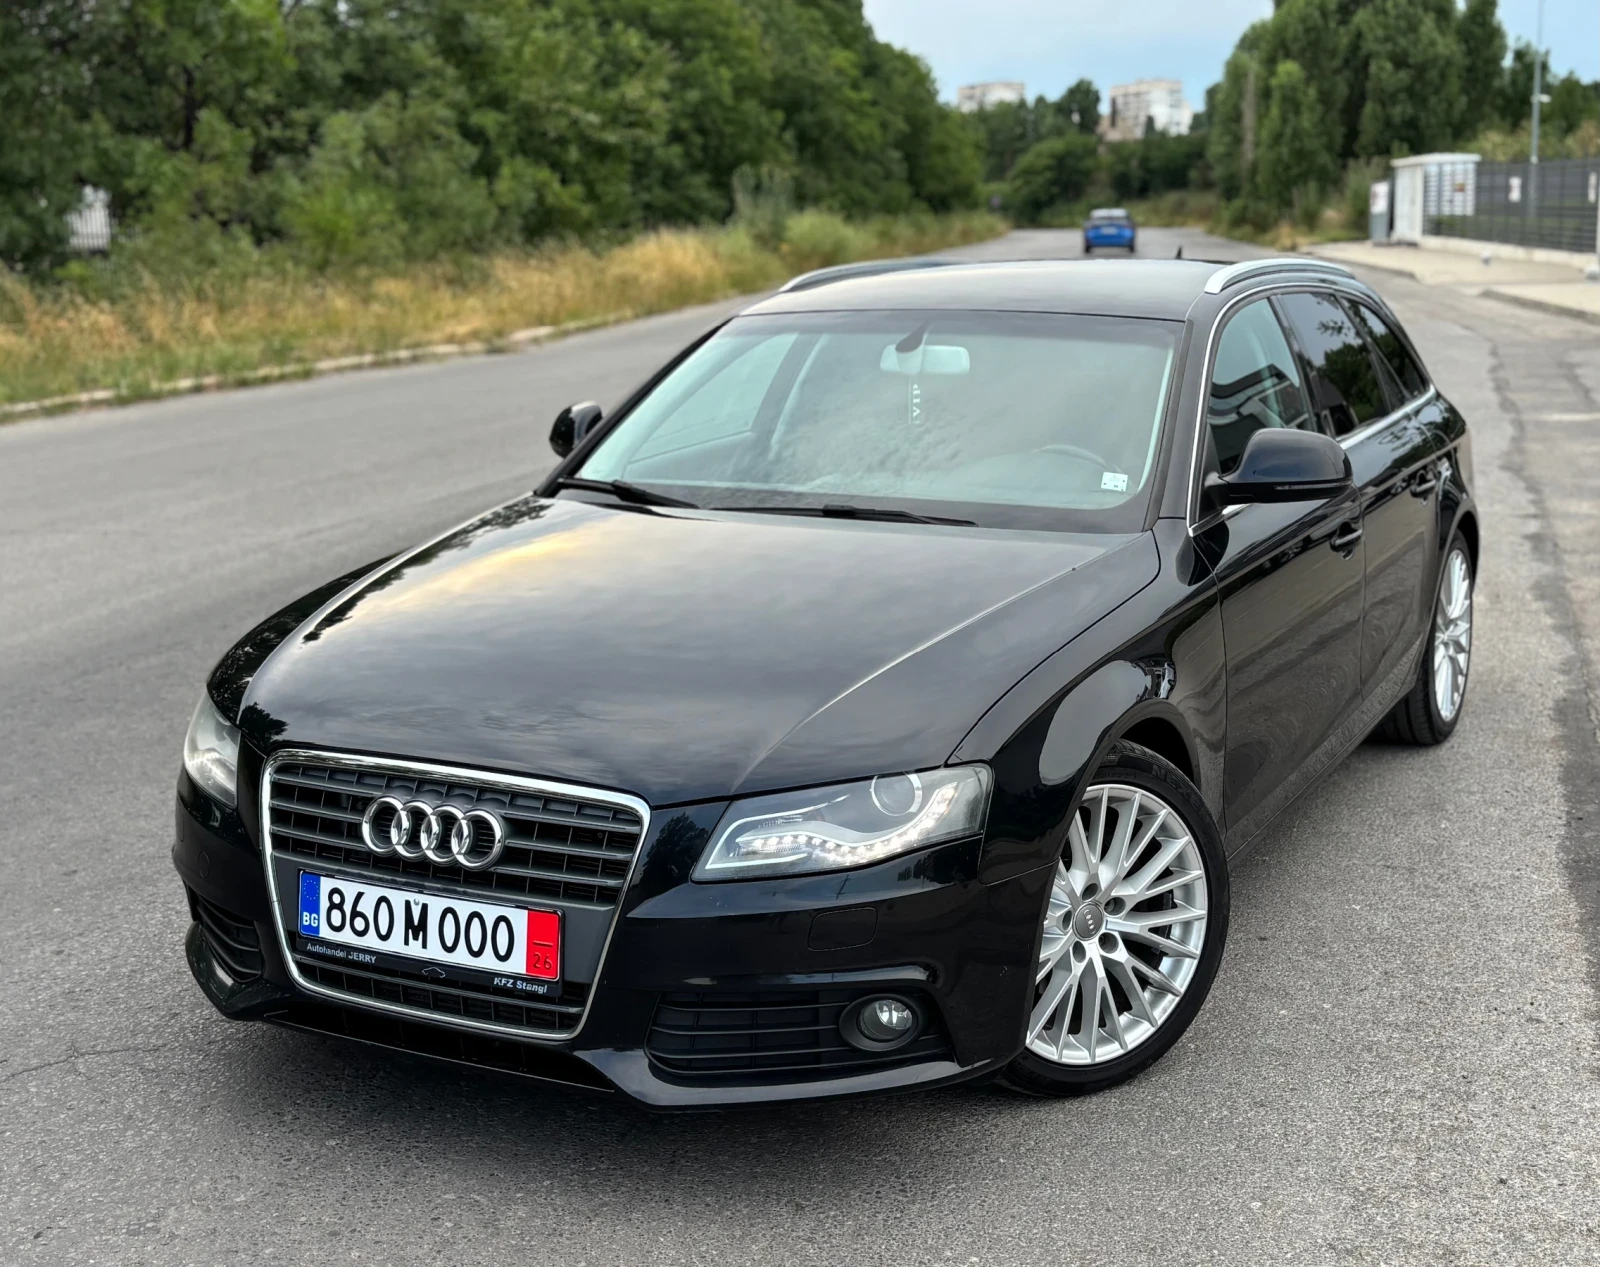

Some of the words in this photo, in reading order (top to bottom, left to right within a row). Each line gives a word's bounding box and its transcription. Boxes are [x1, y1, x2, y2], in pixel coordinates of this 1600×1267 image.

[302, 912, 318, 927] BG
[326, 887, 394, 942] 860
[404, 899, 428, 949] M
[438, 906, 515, 962] 000
[306, 942, 347, 958] Autohandel
[348, 951, 377, 964] JERRY
[532, 952, 552, 970] 26
[493, 977, 514, 988] KFZ
[516, 980, 548, 994] Stangl
